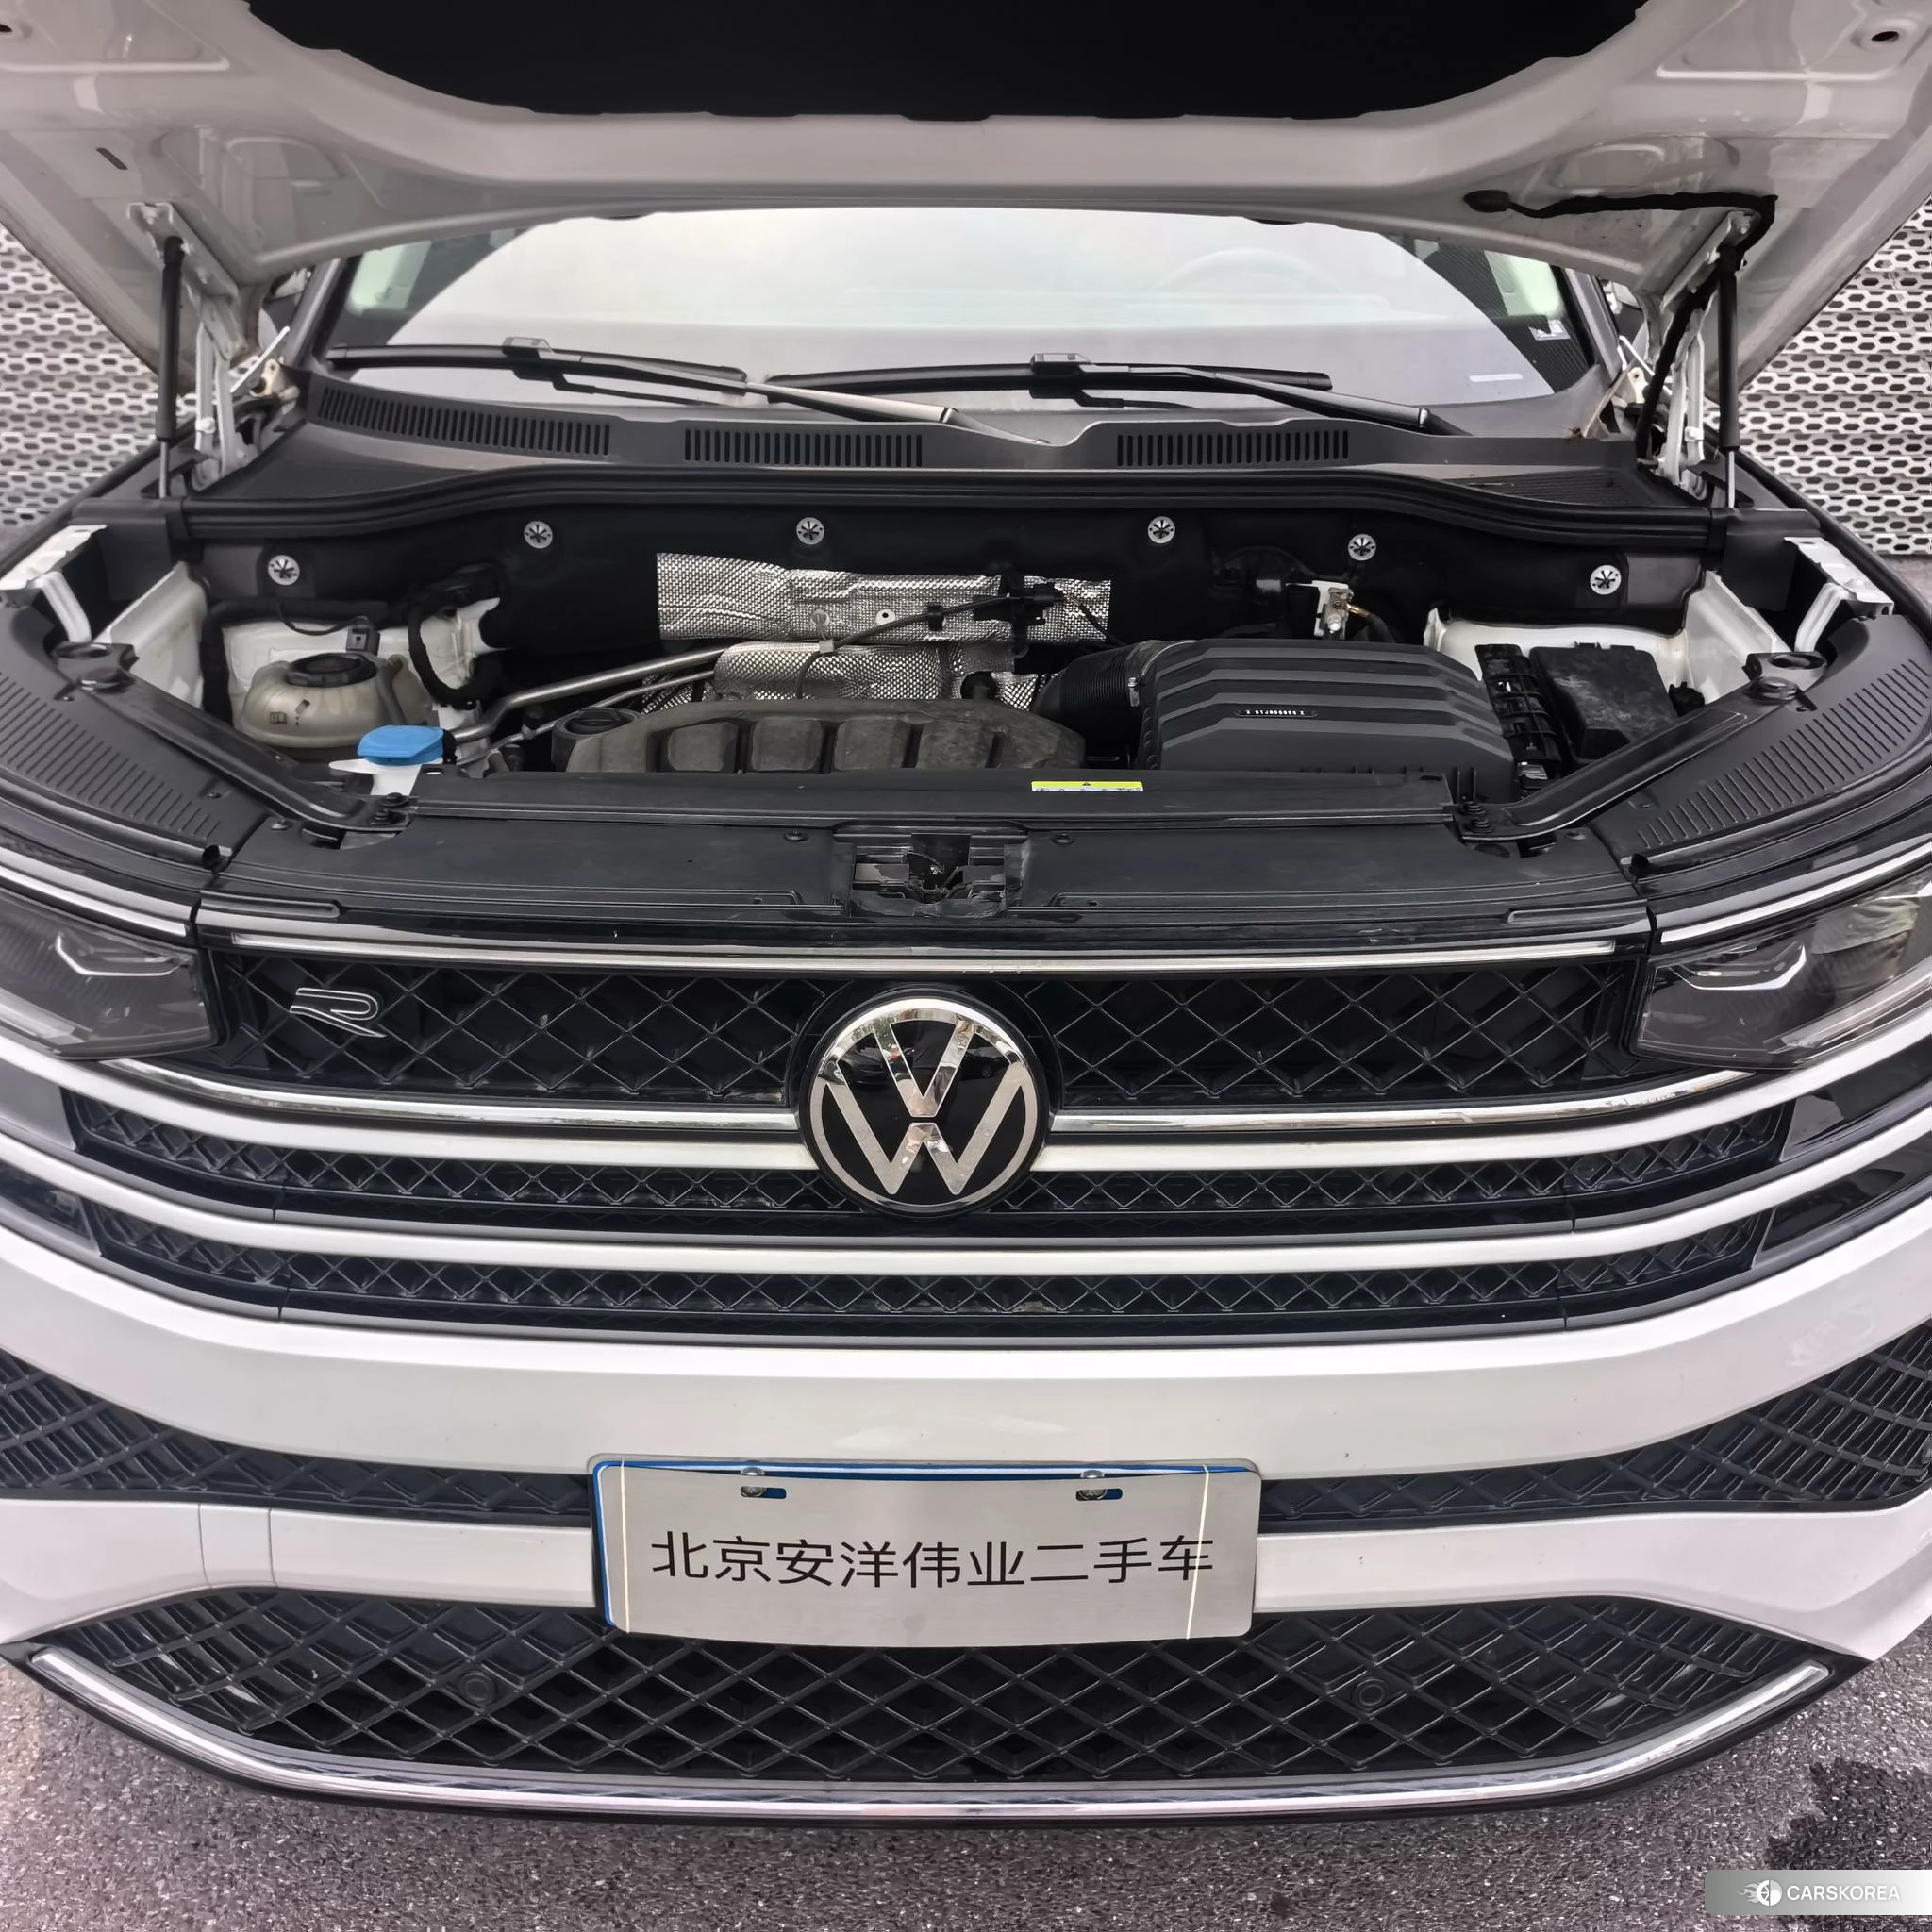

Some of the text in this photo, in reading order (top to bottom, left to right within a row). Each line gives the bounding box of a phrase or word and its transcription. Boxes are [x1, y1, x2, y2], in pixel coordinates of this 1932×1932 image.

[290, 987, 387, 1038] R
[819, 1013, 1030, 1200] VW
[651, 1530, 1215, 1589] 北京安洋伟业二手车
